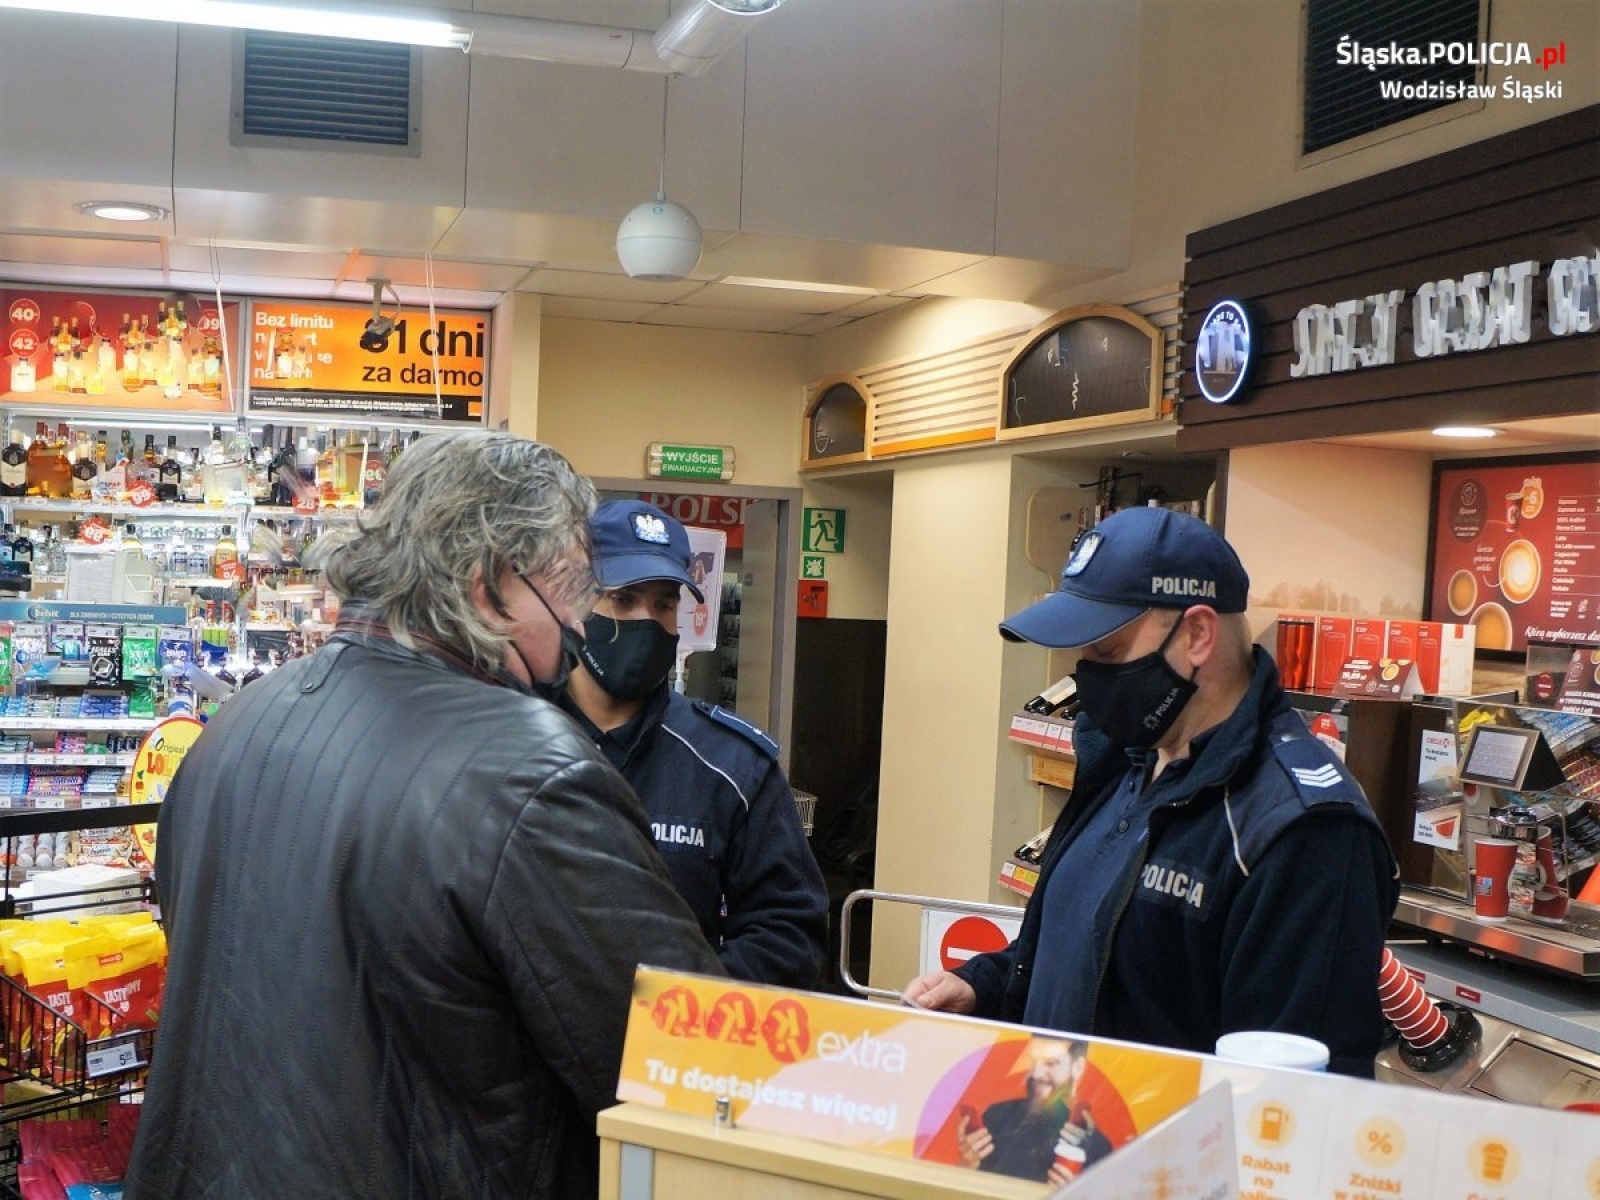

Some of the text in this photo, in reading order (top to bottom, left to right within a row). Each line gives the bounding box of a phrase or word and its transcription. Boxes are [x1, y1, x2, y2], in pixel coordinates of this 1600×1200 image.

[255, 311, 334, 329] Bez limitu
[419, 320, 484, 358] dni
[362, 363, 483, 386] za darmo
[666, 451, 718, 465] WYJŚCIE
[1151, 577, 1217, 598] POLICJA
[651, 822, 705, 848] OLICJA
[816, 1031, 906, 1073] extra
[646, 1058, 898, 1132] Tu dostajesz więcej
[1241, 1154, 1291, 1175] Rabat
[1254, 1176, 1275, 1189] na
